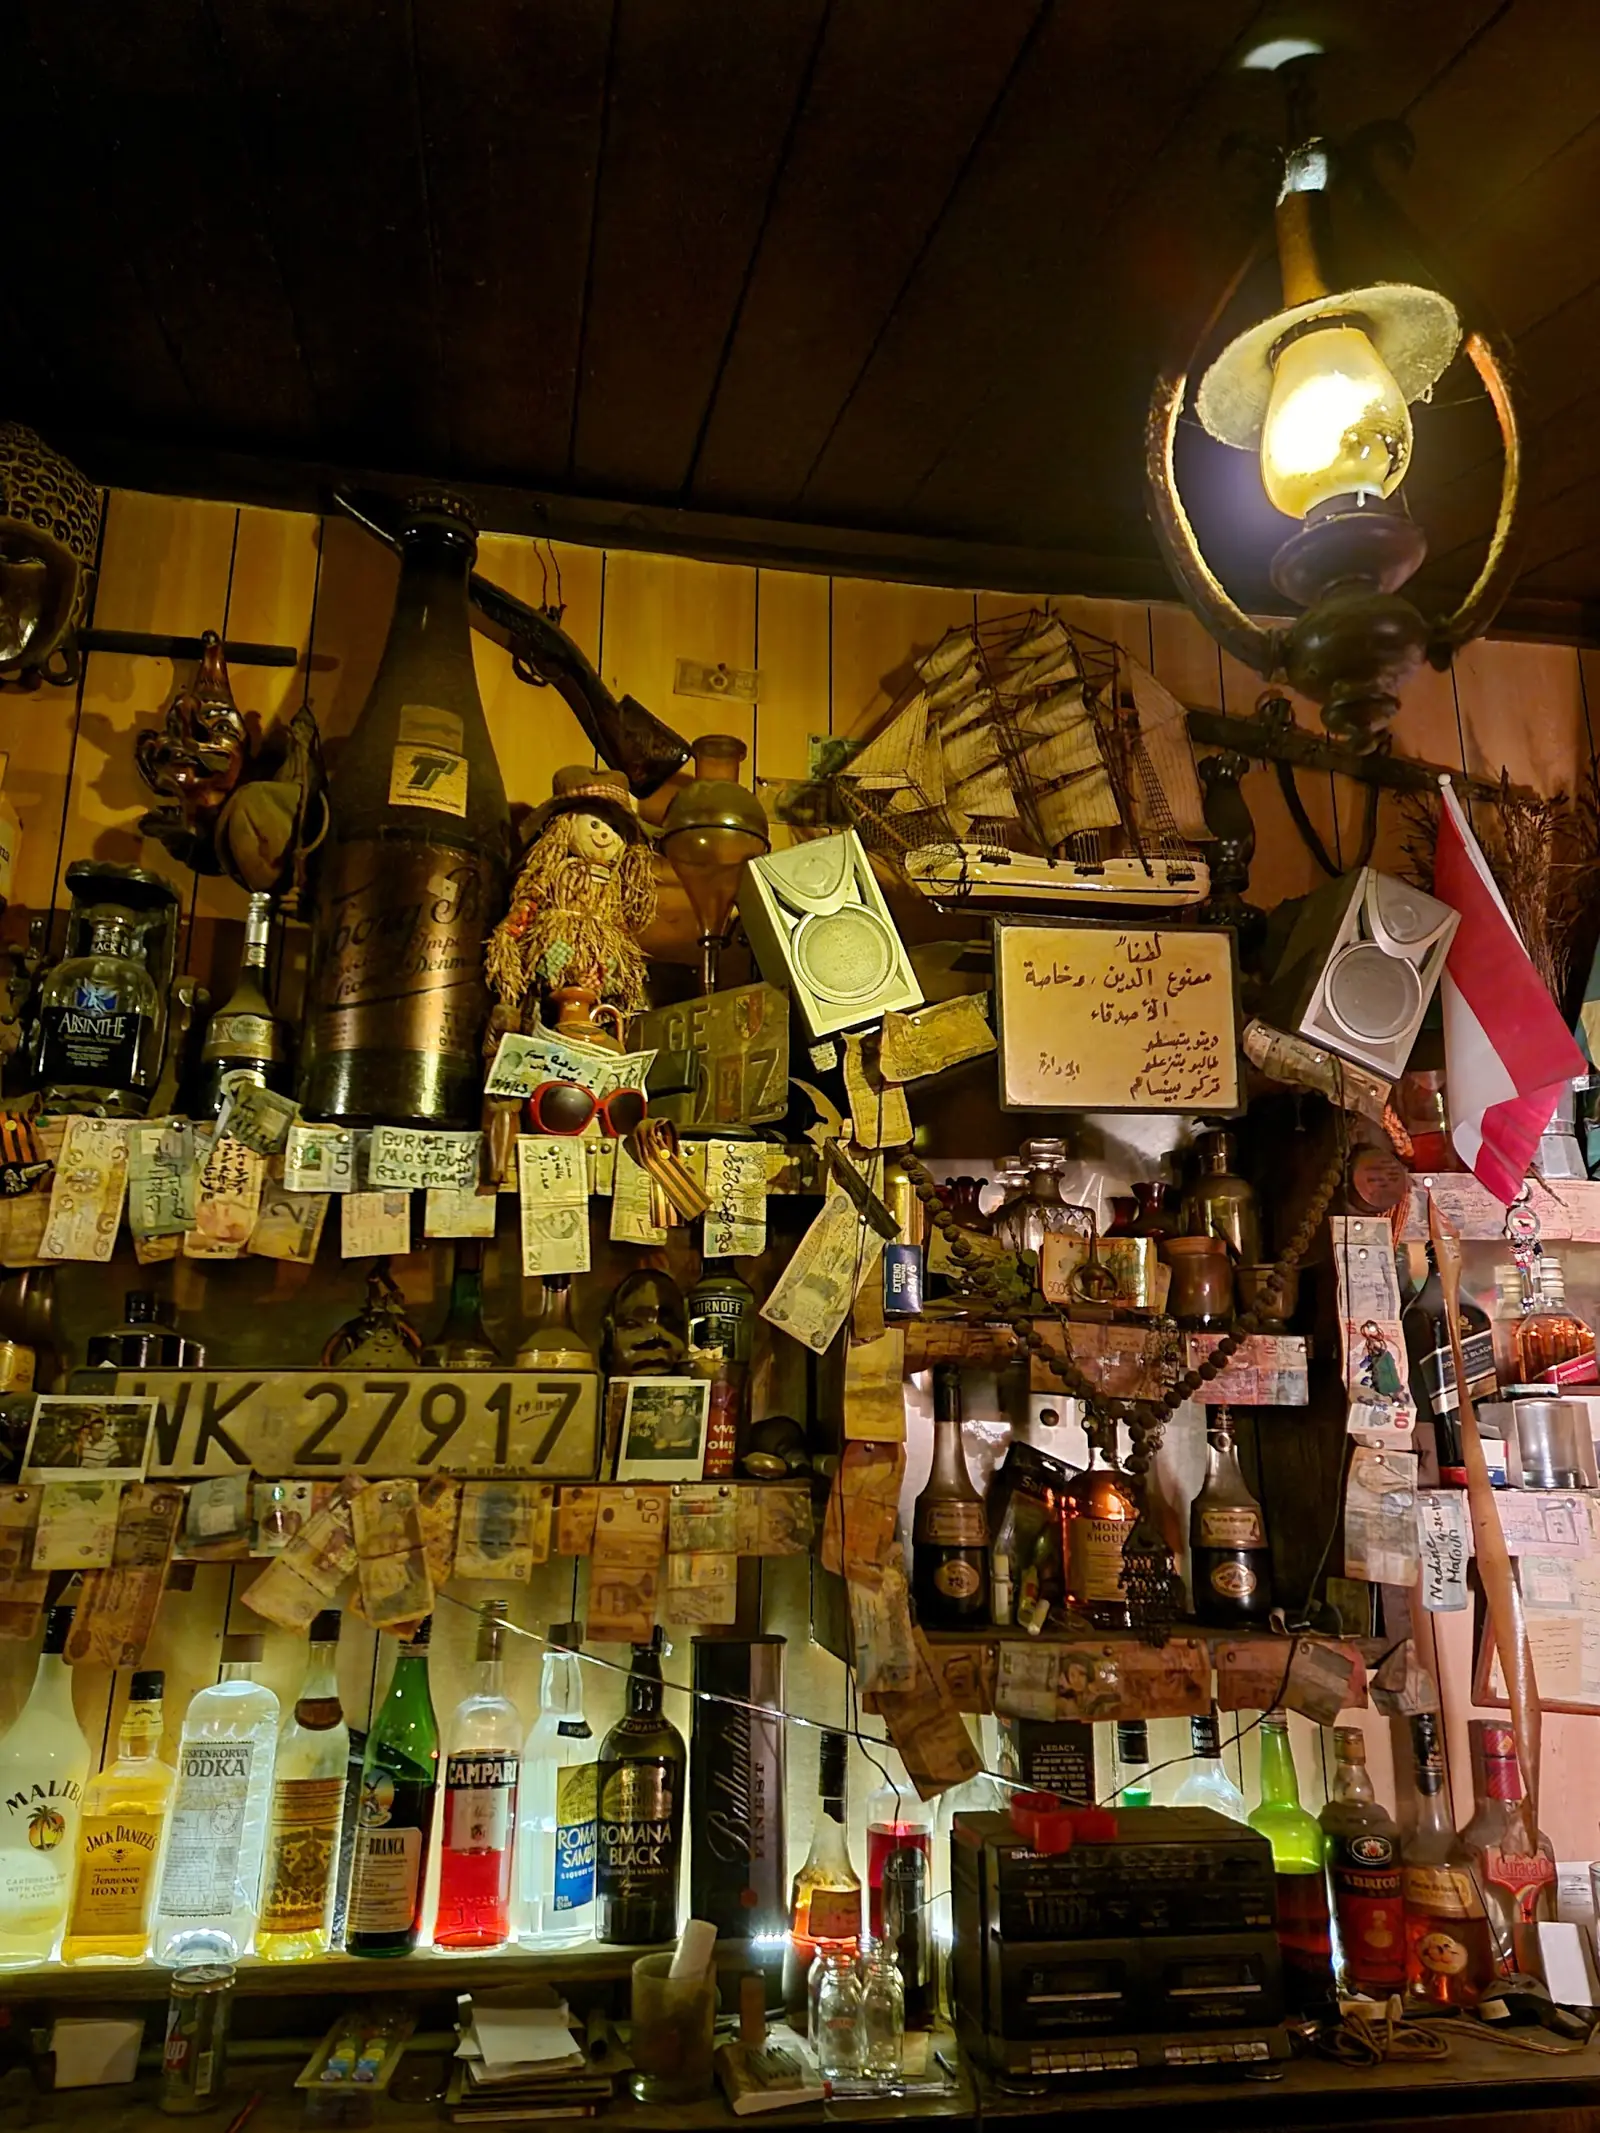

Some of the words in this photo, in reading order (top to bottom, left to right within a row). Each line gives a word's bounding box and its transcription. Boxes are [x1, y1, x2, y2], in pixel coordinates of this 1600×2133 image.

[1167, 967, 1212, 997] ممنوع
[58, 1012, 127, 1039] ABSINTHE
[334, 1153, 349, 1174] 5
[528, 1250, 541, 1272] 20
[893, 1263, 902, 1293] EXTEND
[907, 1264, 918, 1293] 24/6
[694, 1300, 741, 1314] MIRNOFF
[294, 1382, 582, 1466] 27917
[1394, 1410, 1410, 1430] 10
[641, 1497, 661, 1525] 50
[1426, 1531, 1444, 1600] Nadine
[1447, 1528, 1462, 1584] Maroun
[1040, 1743, 1076, 1753] LEGACY
[448, 1760, 518, 1785] CAMPARI
[85, 1830, 114, 1854] JACK
[557, 1824, 596, 1850] ROMA
[601, 1821, 673, 1846] ROMANA
[608, 1847, 661, 1866] BLACK
[90, 1886, 140, 1897] HONEY
[91, 1874, 140, 1886] Tennessee
[166, 2039, 188, 2063] up
